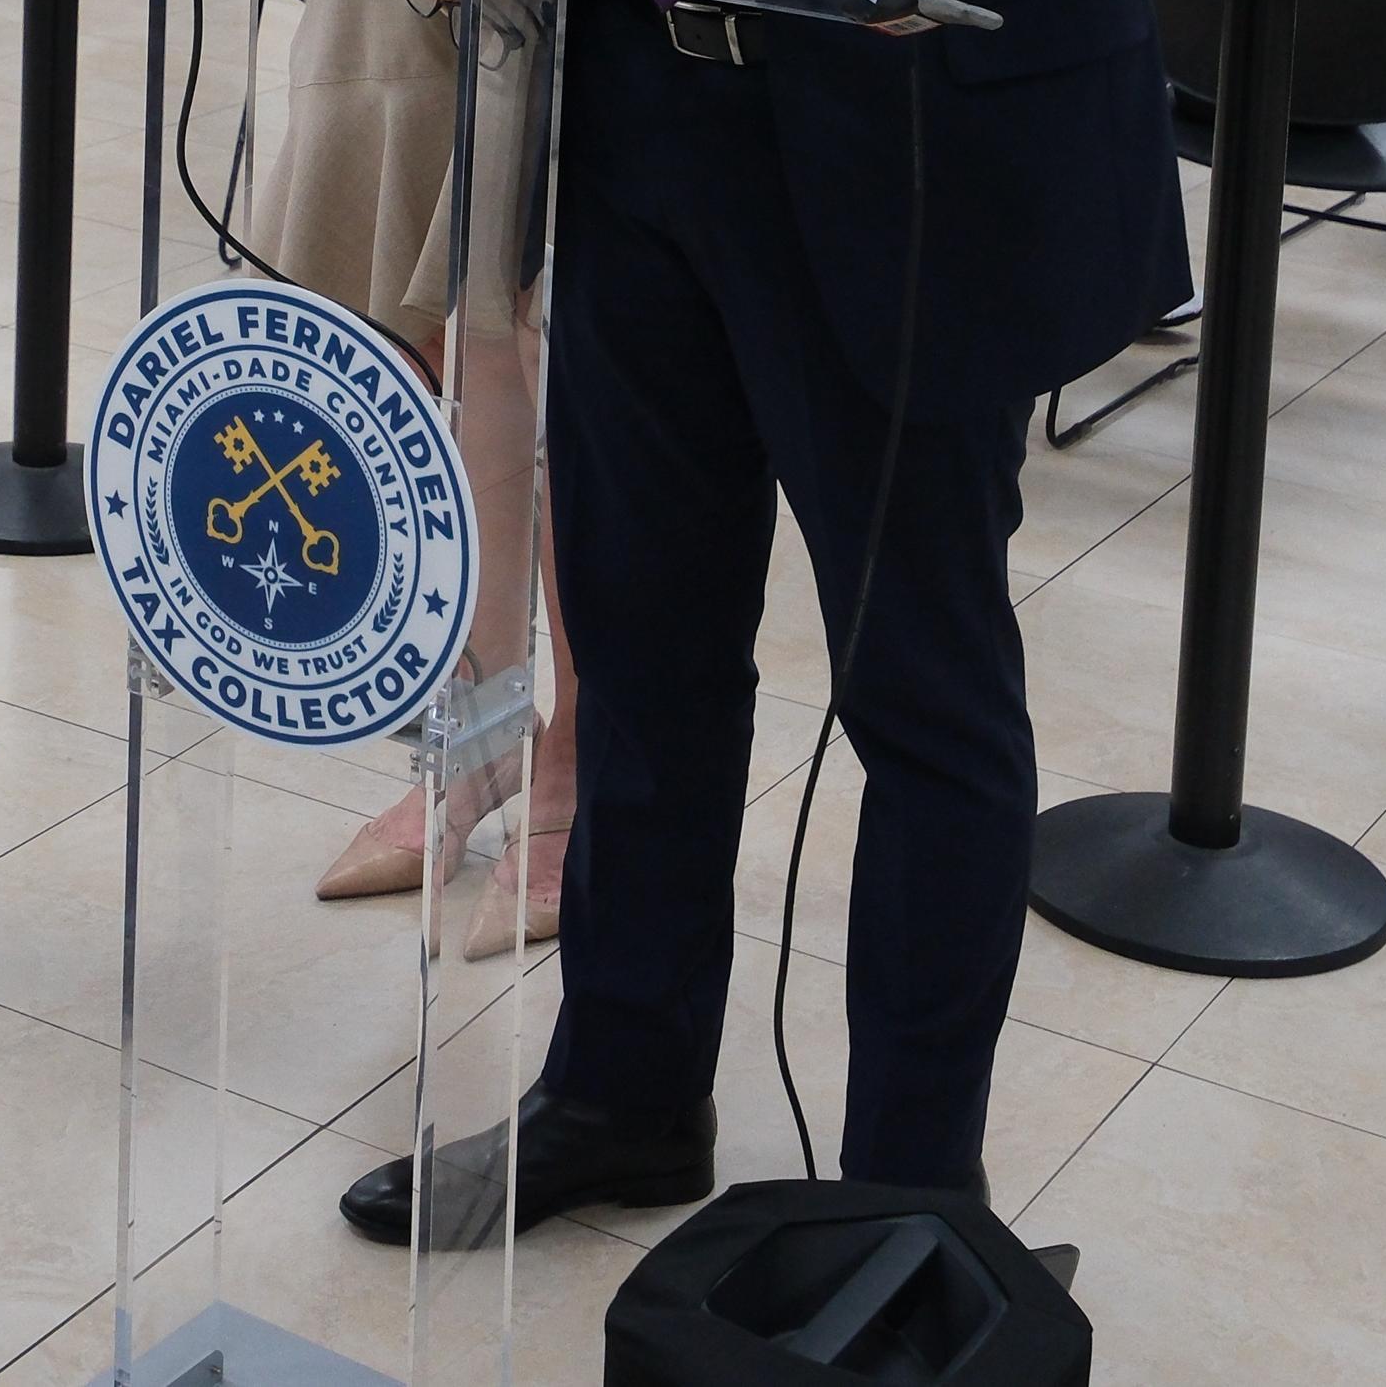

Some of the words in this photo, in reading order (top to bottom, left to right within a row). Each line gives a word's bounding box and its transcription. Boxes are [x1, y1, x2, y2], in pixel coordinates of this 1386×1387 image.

[107, 313, 224, 450] DARIEL
[237, 306, 453, 540] FERNANDEZ
[147, 358, 313, 464] MIAMI-DADE
[327, 392, 409, 538] COUNTY
[268, 521, 279, 532] N
[221, 555, 235, 568] W
[308, 581, 317, 595] E
[122, 555, 186, 656] TAX
[192, 641, 430, 730] COLLECTOR
[169, 576, 194, 607] IN
[195, 611, 242, 656] GOD
[252, 654, 289, 676] WE
[298, 635, 368, 677] TRUST
[263, 617, 273, 630] S
